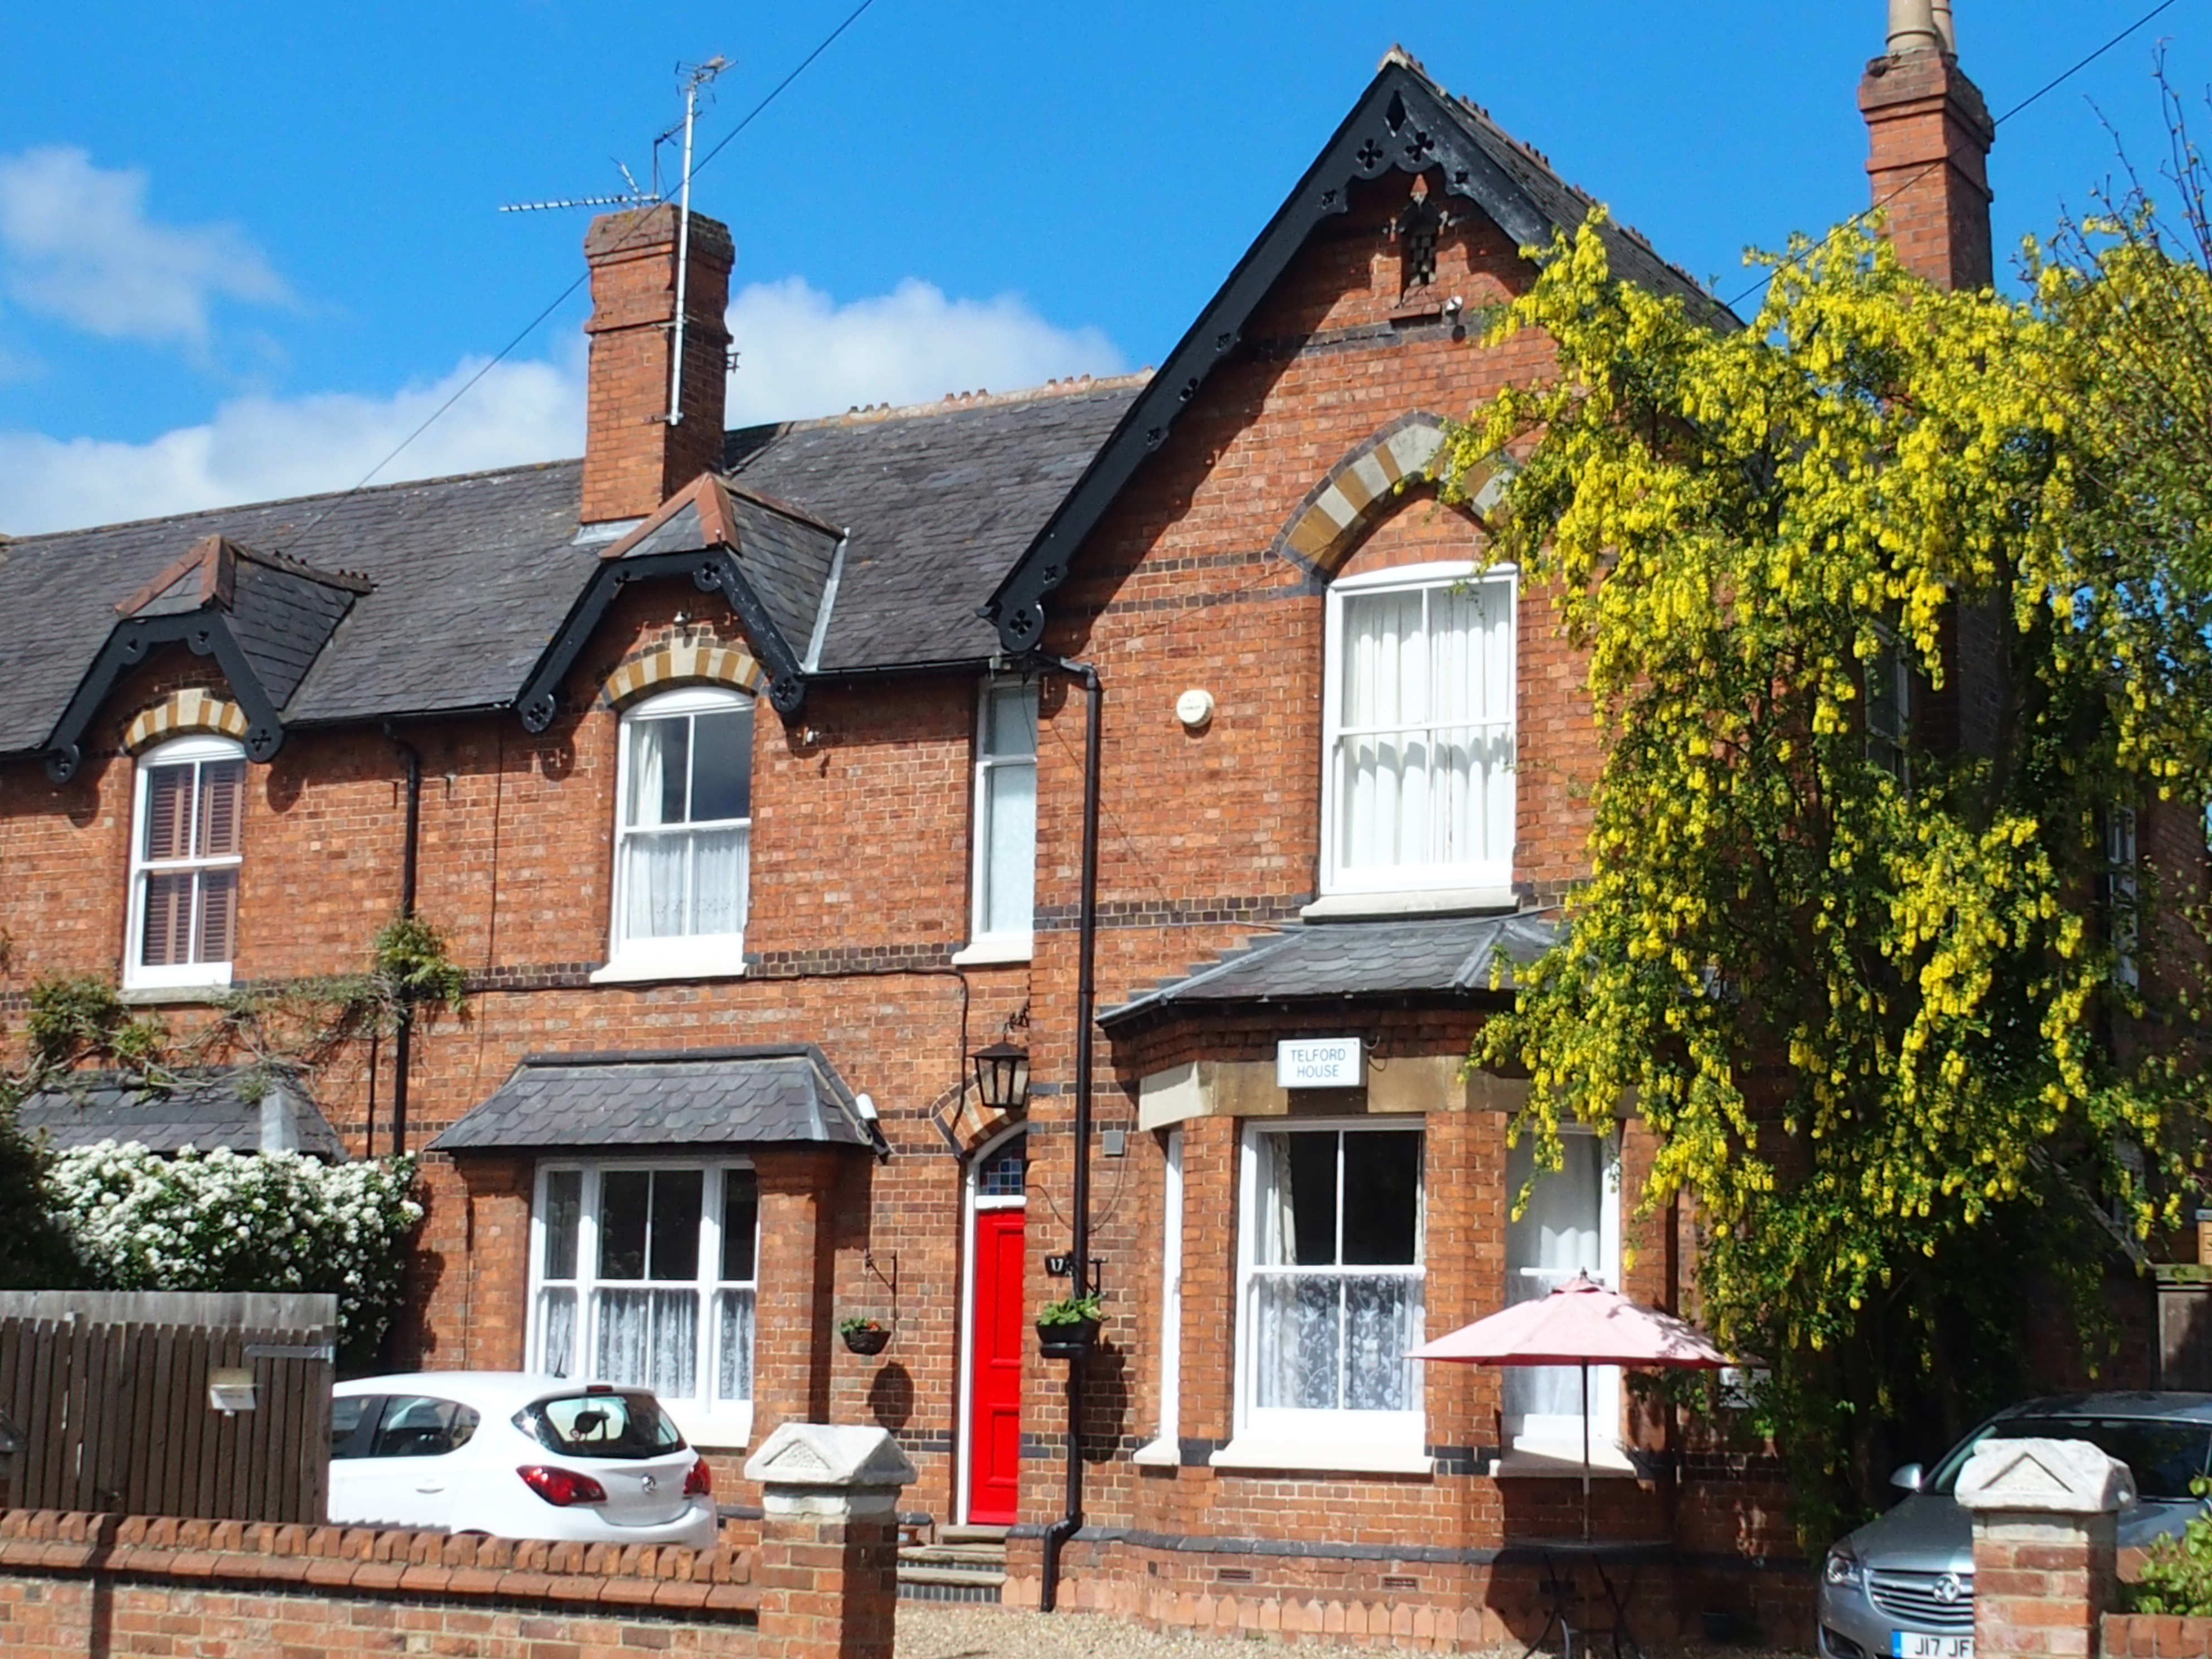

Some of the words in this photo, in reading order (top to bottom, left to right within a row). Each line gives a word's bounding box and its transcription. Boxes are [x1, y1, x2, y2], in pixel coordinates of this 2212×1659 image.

[1290, 1048, 1346, 1063] TELFORD
[1296, 1064, 1340, 1079] HOUSE
[1914, 1637, 1941, 1656] J17
[1947, 1637, 1976, 1657] JF
